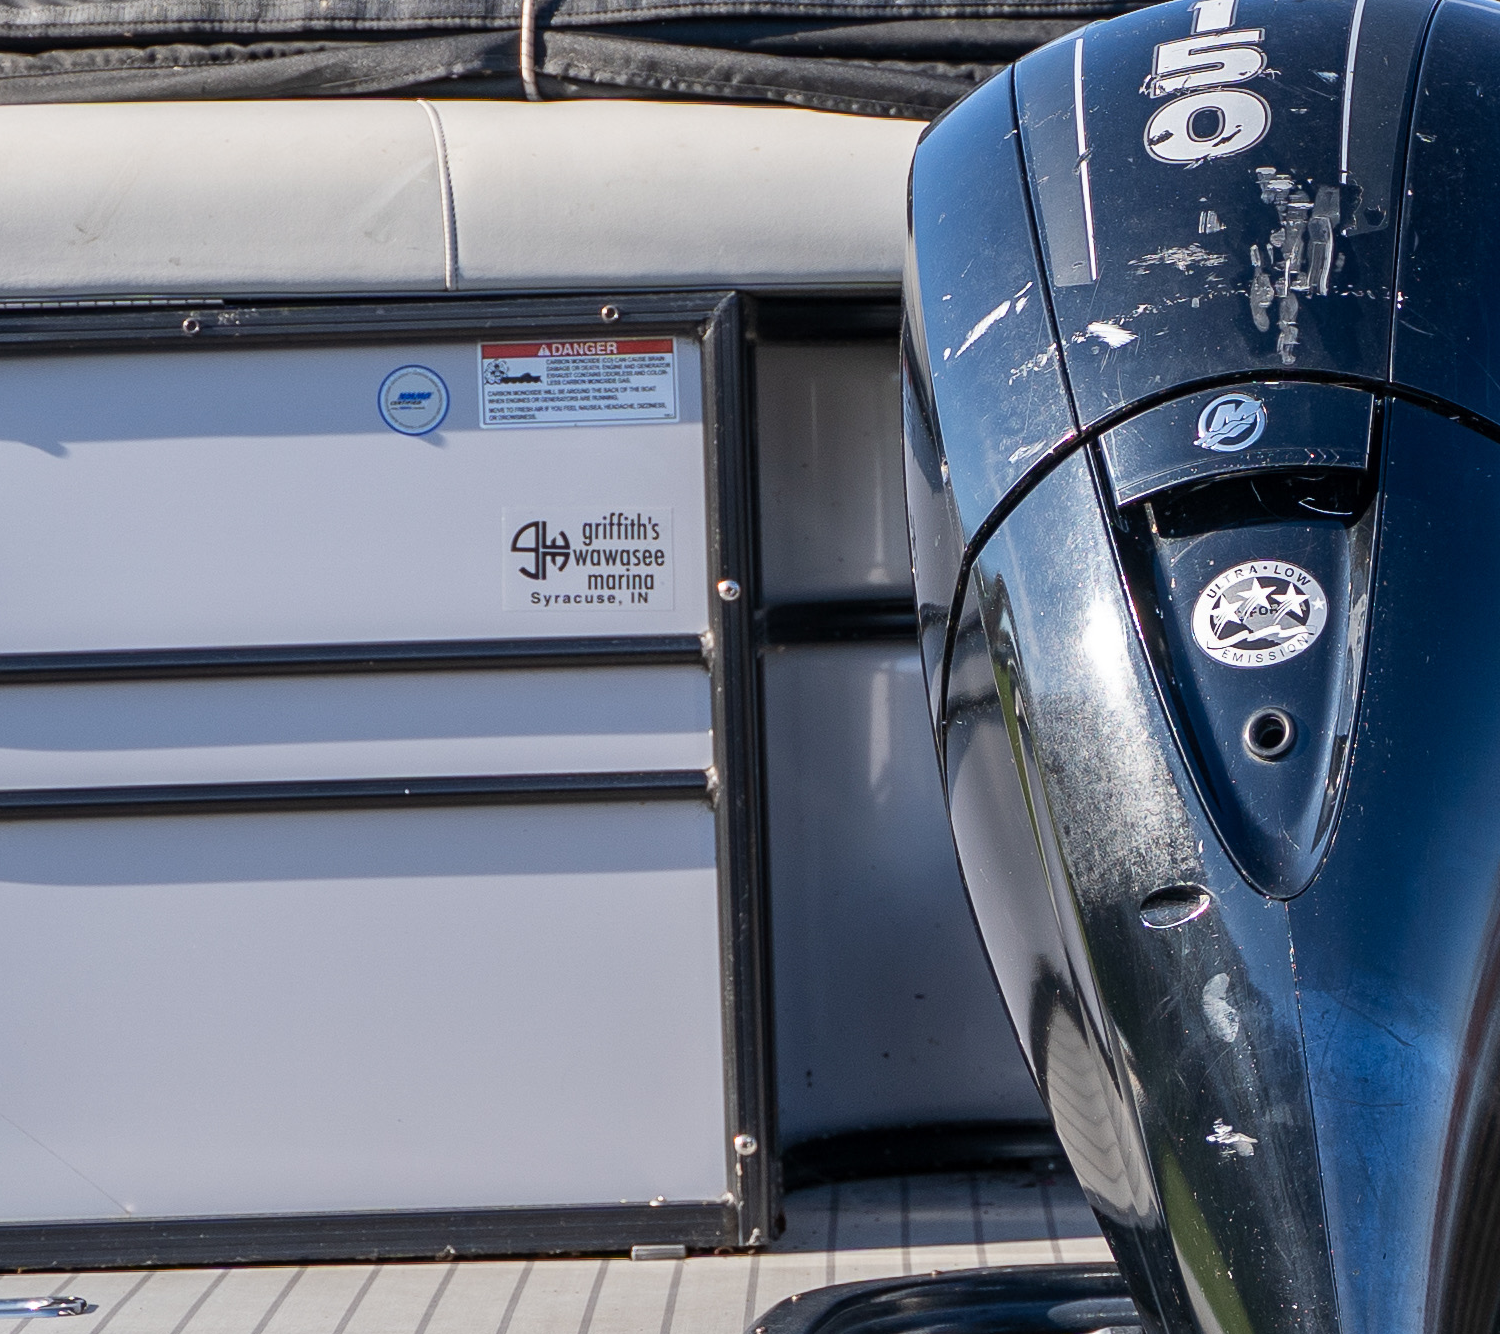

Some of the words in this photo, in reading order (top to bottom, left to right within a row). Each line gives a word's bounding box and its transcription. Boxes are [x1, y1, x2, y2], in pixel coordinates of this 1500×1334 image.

[552, 342, 617, 356] DANGER
[582, 512, 660, 546] griffith's
[573, 549, 665, 567] wawasee
[588, 568, 654, 590] marina
[1207, 564, 1258, 599] ULTRA
[1274, 564, 1311, 586] LOW
[530, 591, 623, 607] Syracuse,
[631, 591, 649, 604] IN
